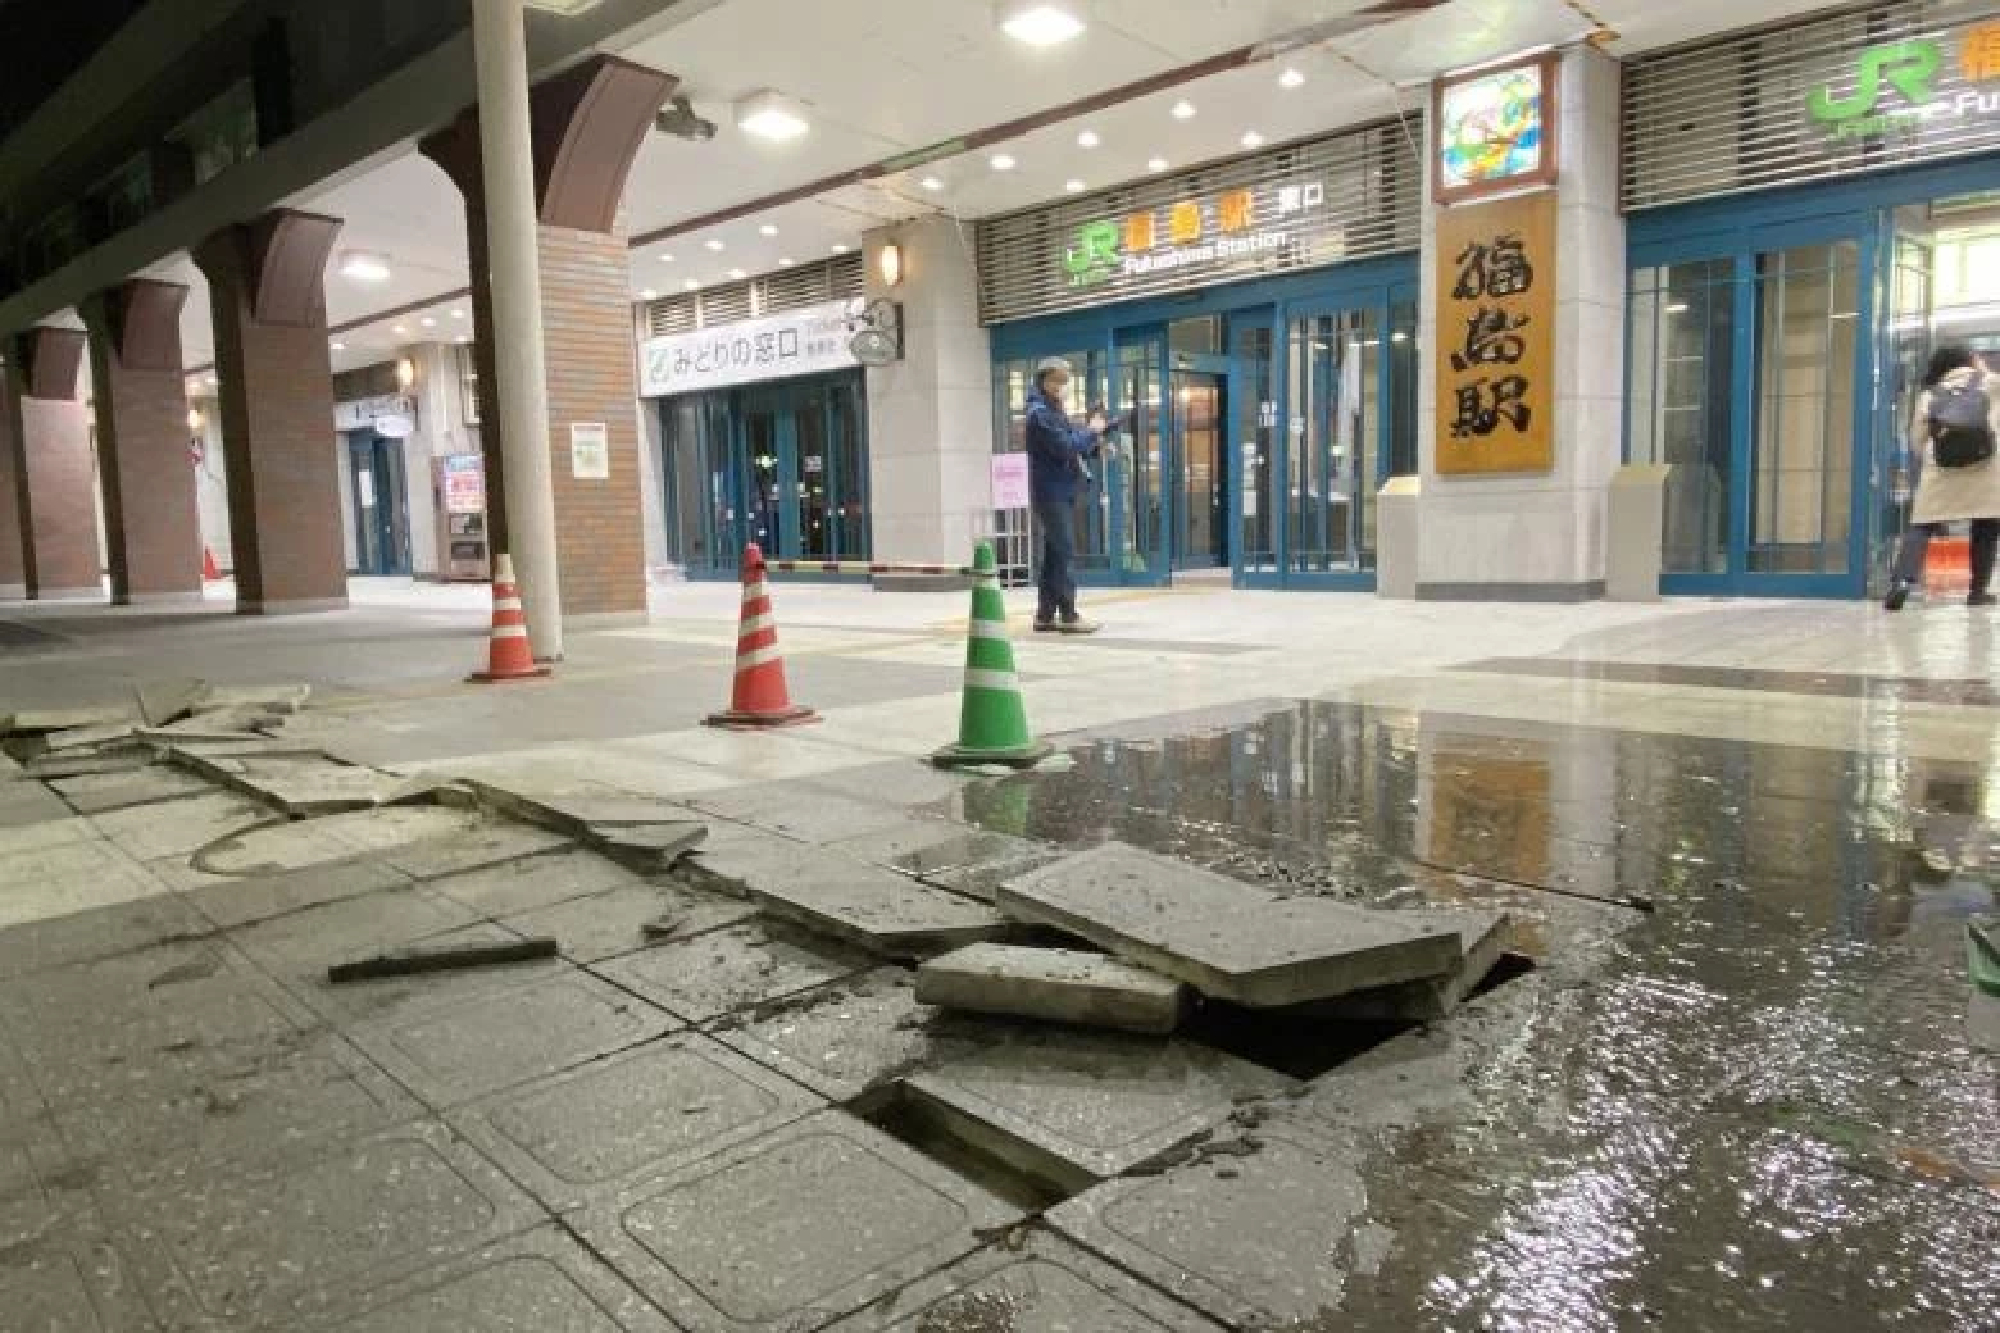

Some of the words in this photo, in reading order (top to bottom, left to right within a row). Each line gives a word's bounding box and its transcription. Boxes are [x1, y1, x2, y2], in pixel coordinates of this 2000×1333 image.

[1806, 38, 1941, 122] JR
[1065, 219, 1119, 272] JR
[672, 327, 798, 375] みどりの窓口
